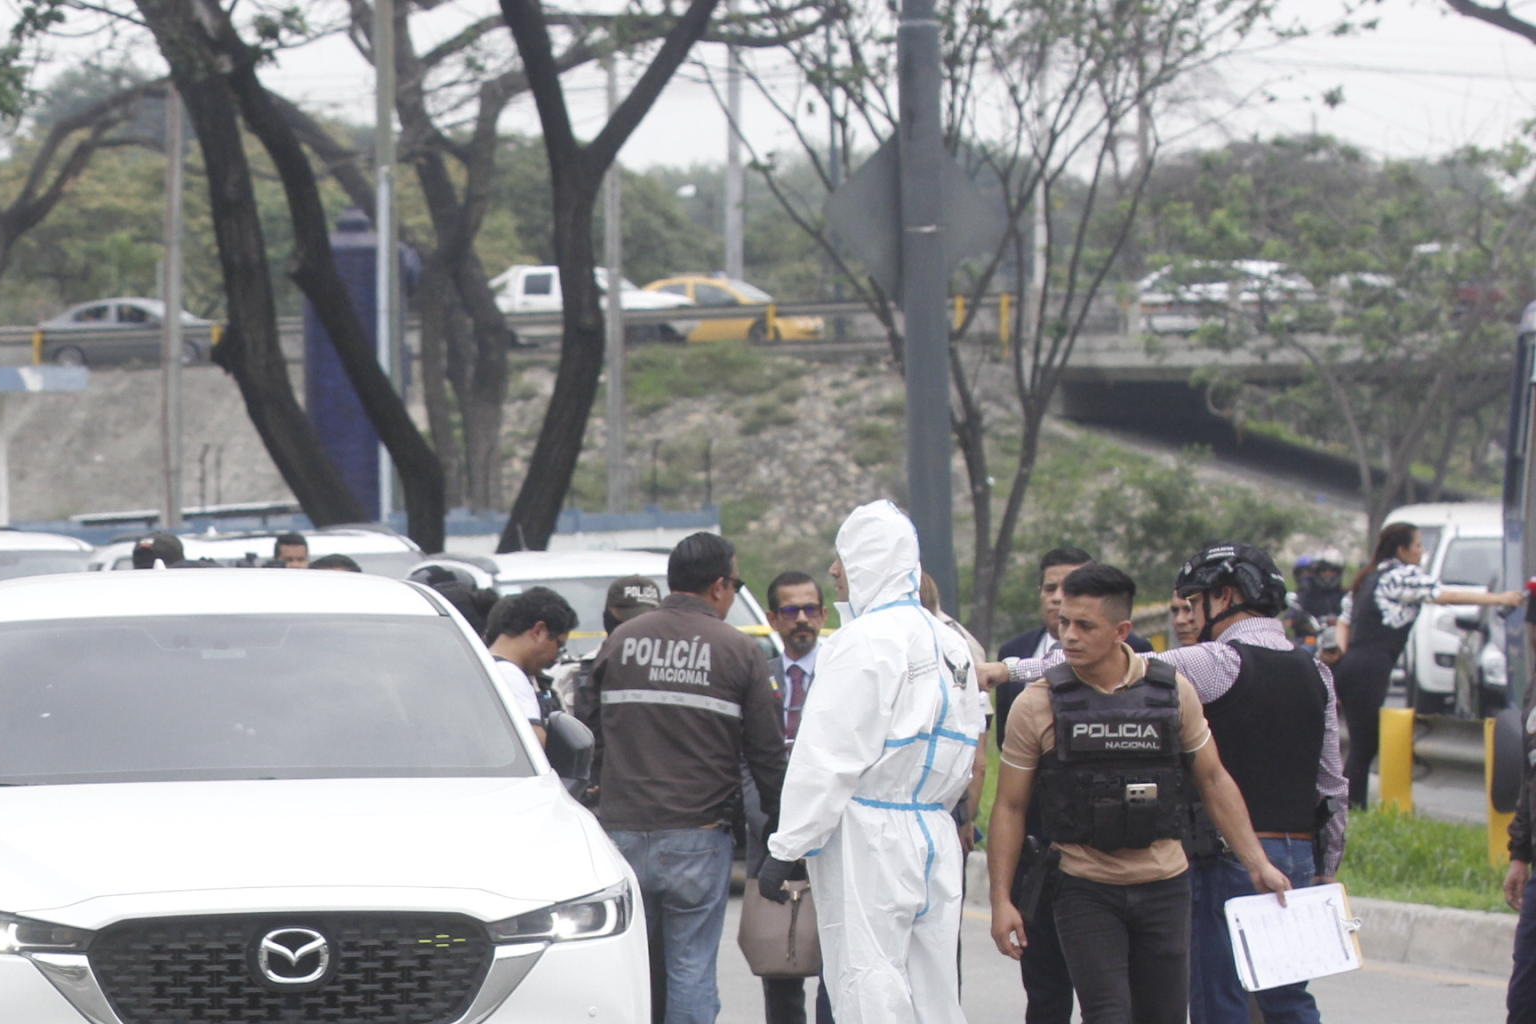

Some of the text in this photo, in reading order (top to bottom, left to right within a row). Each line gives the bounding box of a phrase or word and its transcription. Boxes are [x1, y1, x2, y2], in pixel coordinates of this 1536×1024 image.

[622, 636, 711, 671] POLICÍA
[649, 667, 710, 686] NACIONAL
[1073, 724, 1159, 738] POLICIA
[1105, 741, 1160, 750] NACIONAL
